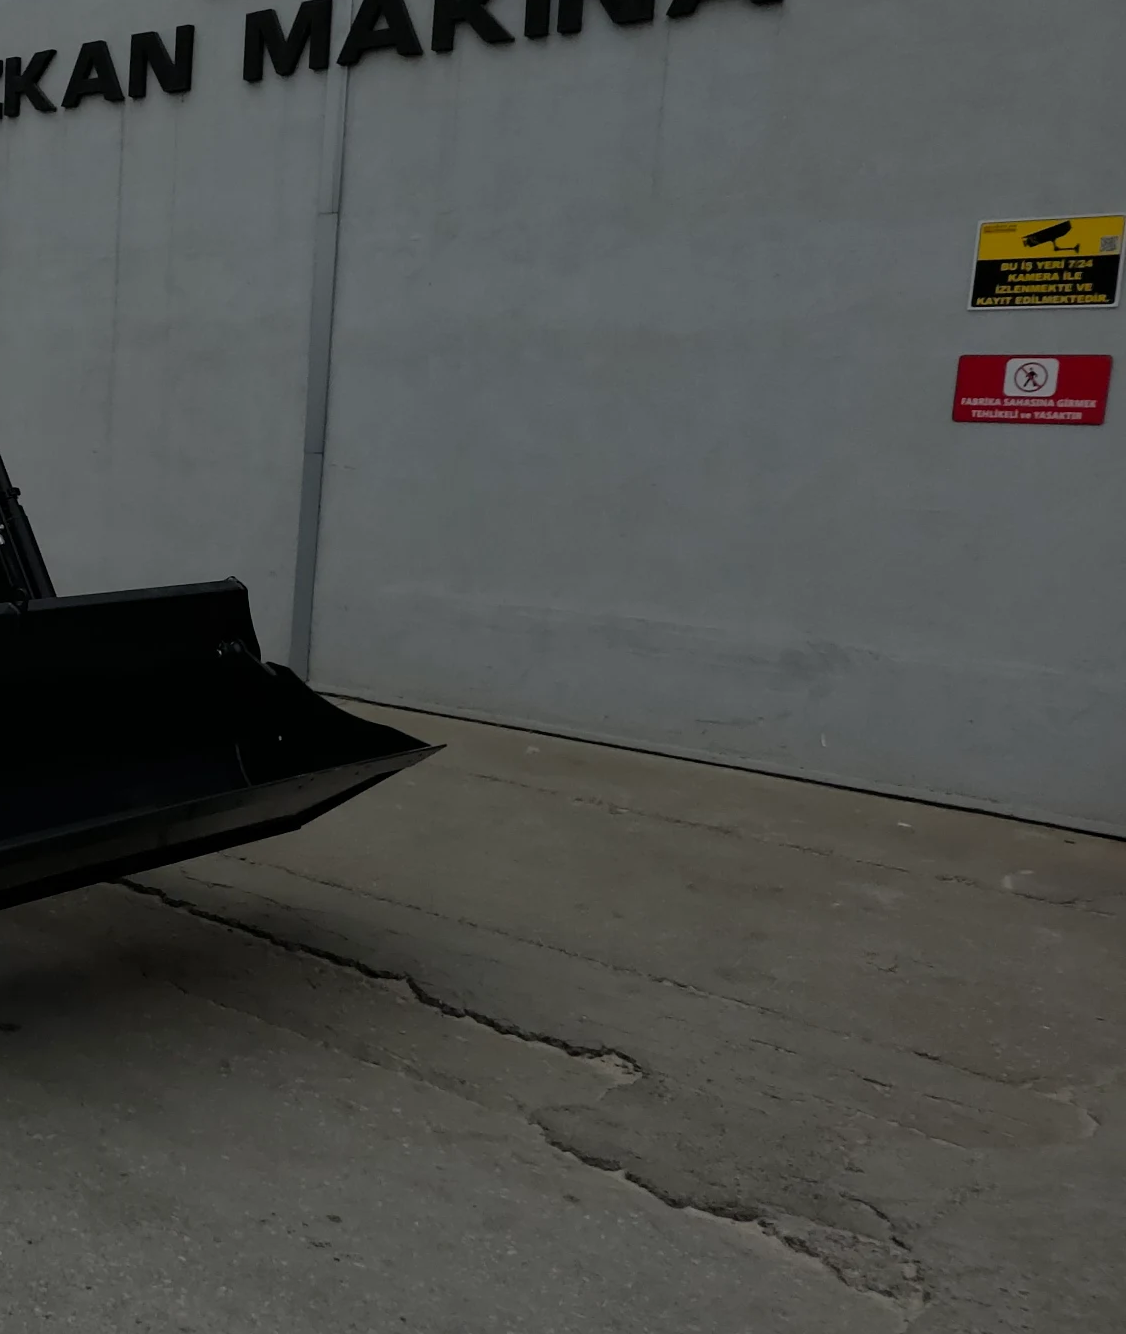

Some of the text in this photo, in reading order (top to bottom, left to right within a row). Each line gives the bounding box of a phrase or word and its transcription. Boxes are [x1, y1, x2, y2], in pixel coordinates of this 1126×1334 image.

[1000, 262, 1017, 271] BU
[1037, 259, 1065, 269] YERİ
[1007, 271, 1083, 282] KAMERA İLE
[995, 283, 1093, 294] İZLENMEKTE VE
[976, 297, 1013, 305] KAYIT
[961, 397, 1001, 406] FABRİKA
[1003, 398, 1055, 407] SAHASINA
